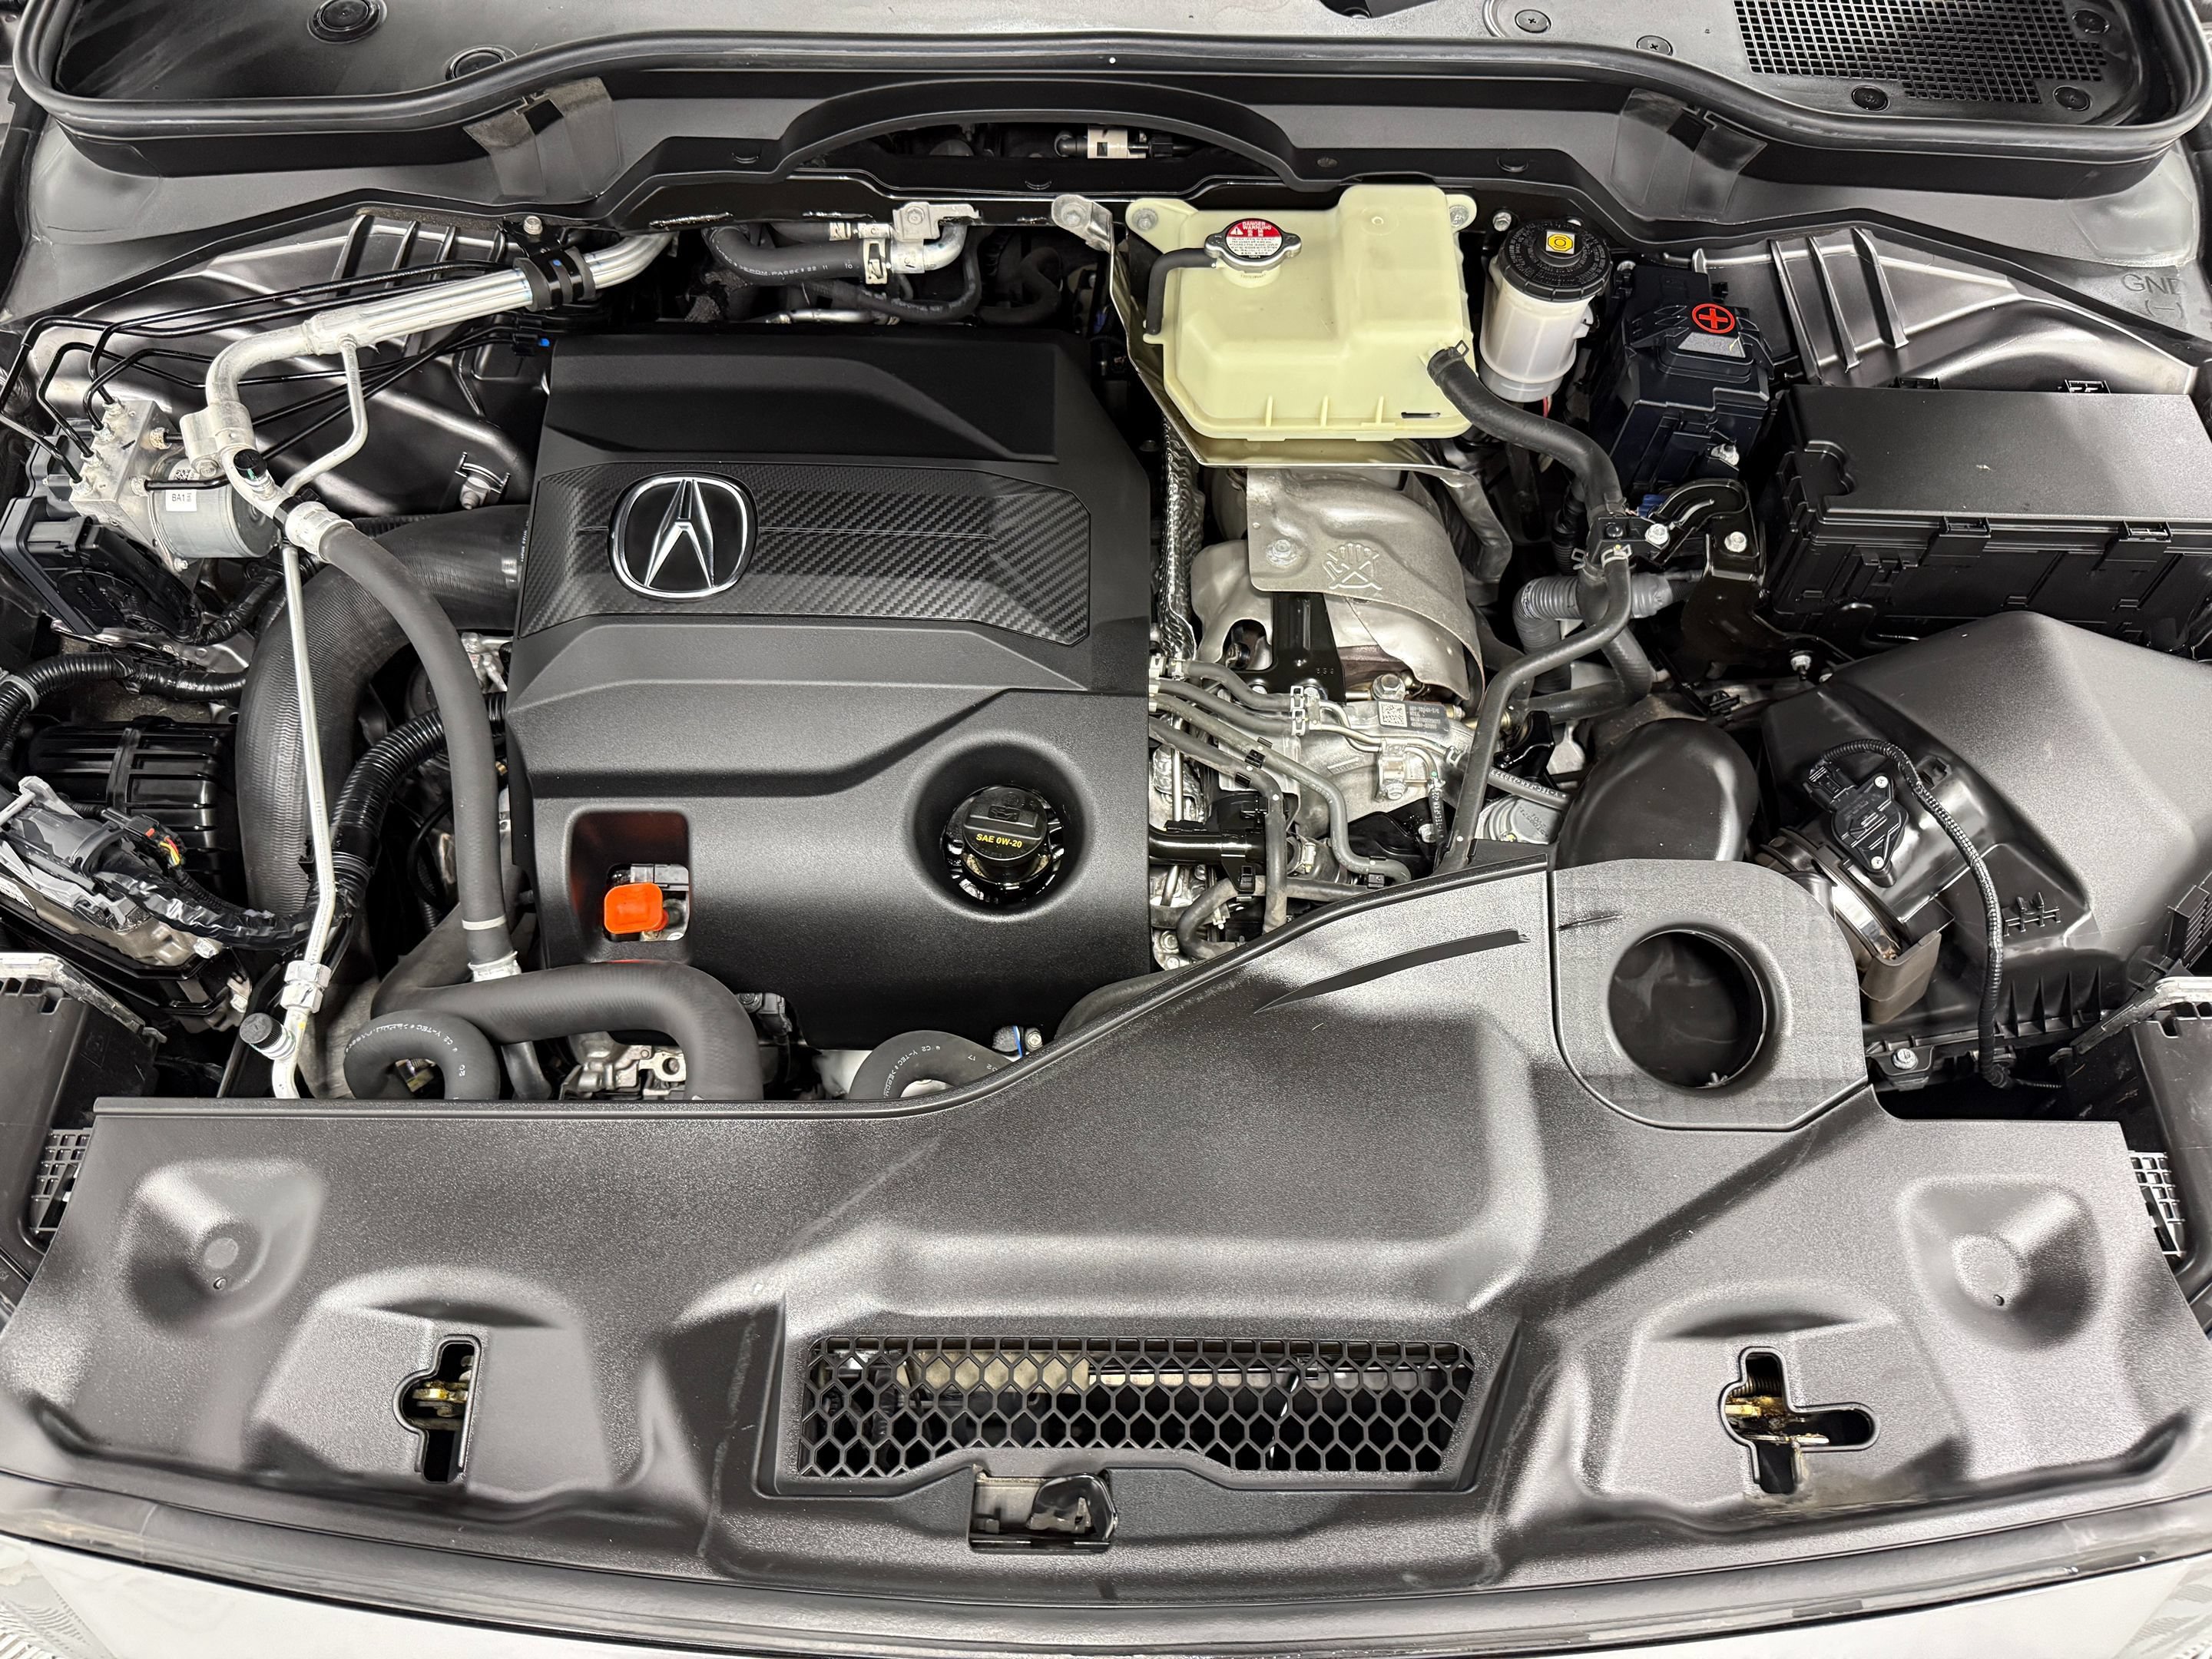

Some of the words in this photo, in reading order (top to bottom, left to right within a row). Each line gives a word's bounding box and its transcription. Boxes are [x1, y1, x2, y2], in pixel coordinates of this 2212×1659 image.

[2121, 273, 2187, 295] GND
[171, 493, 185, 502] BA1
[975, 833, 995, 843] SAE
[995, 836, 1023, 849] 0W-20
[416, 1024, 442, 1038] Y-TEC
[897, 1049, 919, 1066] Y-TEC
